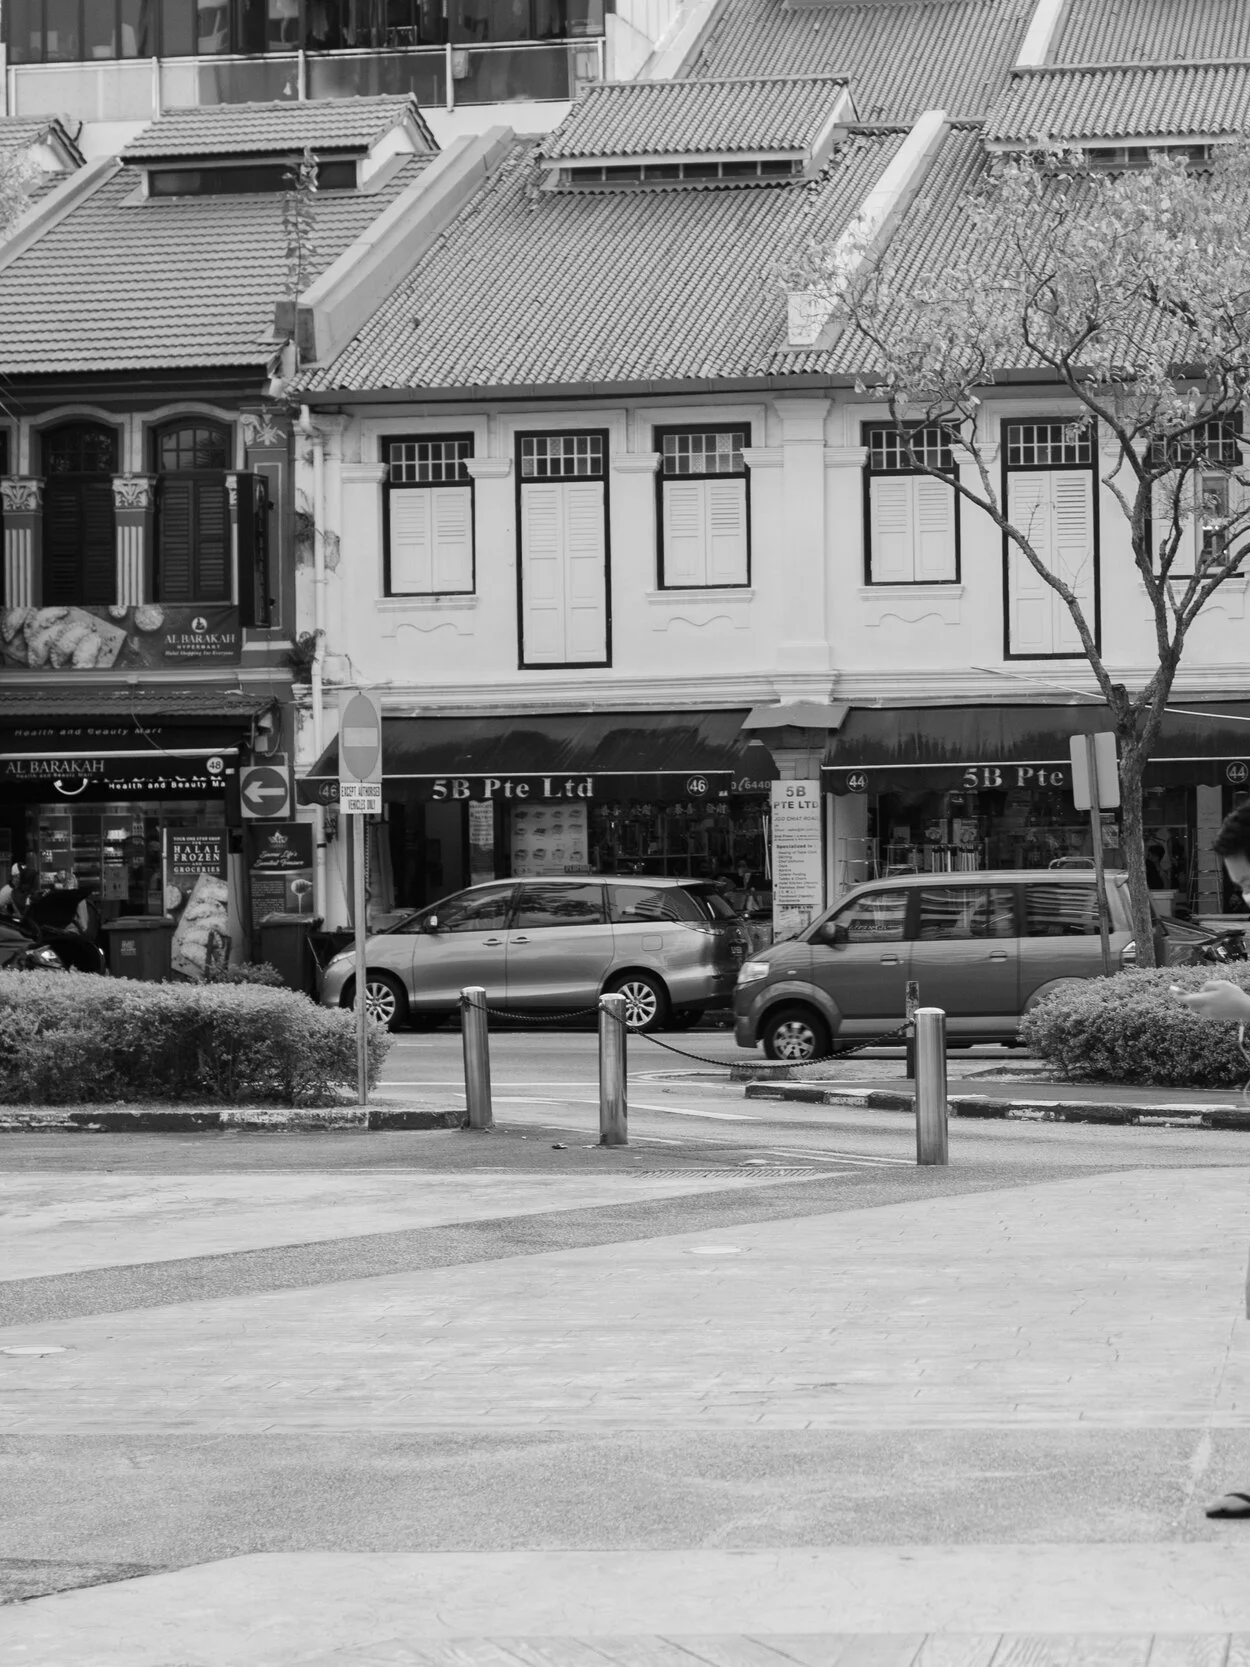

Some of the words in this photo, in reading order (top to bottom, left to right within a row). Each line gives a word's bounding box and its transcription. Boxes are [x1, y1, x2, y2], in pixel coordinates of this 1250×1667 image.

[165, 634, 179, 644] AL
[181, 634, 235, 643] BARAKAH
[59, 728, 82, 736] and
[87, 728, 129, 736] Beauty
[5, 761, 26, 774] AL
[30, 760, 105, 773] BARAKAH
[209, 760, 221, 770] 48
[962, 768, 1003, 789] 5B
[1016, 767, 1065, 788] Pte
[1227, 766, 1247, 779] 44
[171, 781, 206, 789] Beauty
[689, 780, 706, 793] 46
[848, 775, 866, 788] 44
[322, 784, 338, 797] 46
[341, 785, 357, 797] EXCEPT
[432, 779, 471, 800] 5B
[482, 778, 530, 798] Pte
[541, 777, 594, 798] Ltd
[786, 785, 807, 797] 5B
[348, 799, 366, 810] VEHICLES
[366, 799, 375, 810] ONLY
[773, 801, 795, 809] PTE
[798, 800, 819, 809] LTD
[173, 845, 220, 853] HALAL
[173, 853, 220, 862] FROZEN
